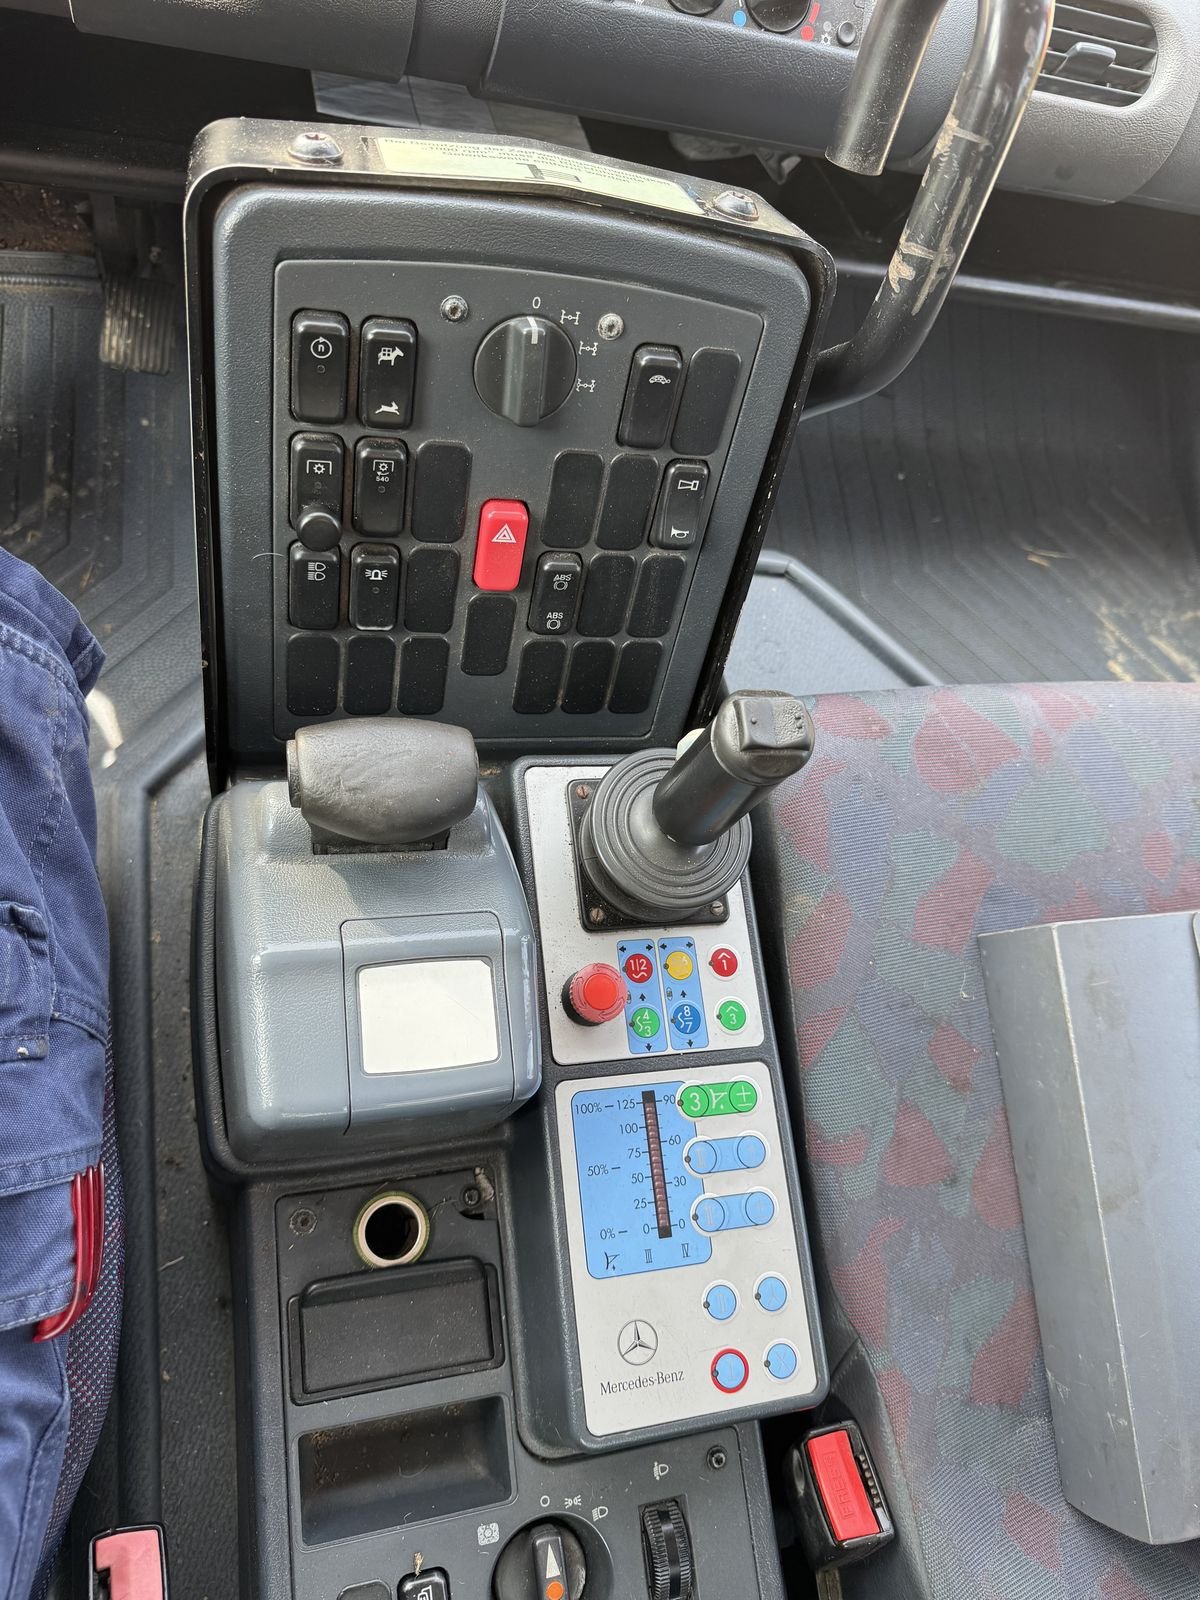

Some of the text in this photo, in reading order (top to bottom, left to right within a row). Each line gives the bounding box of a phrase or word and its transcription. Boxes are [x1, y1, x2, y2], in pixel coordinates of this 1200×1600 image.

[532, 296, 541, 309] 0
[553, 574, 572, 582] ABS
[683, 1005, 691, 1017] 8
[729, 1013, 737, 1025] 3
[685, 1022, 693, 1033] 7
[575, 1094, 676, 1115] 100% 125 90
[689, 1092, 701, 1111] 3
[620, 1122, 639, 1135] 100
[668, 1134, 681, 1145] 60
[627, 1147, 641, 1159] 75
[587, 1163, 609, 1177] 50%
[631, 1172, 644, 1184] 50
[673, 1175, 687, 1187] 30
[633, 1197, 647, 1210] 25
[642, 1223, 650, 1234] 0
[678, 1218, 686, 1229] 0
[600, 1227, 616, 1240] 0%
[600, 1370, 684, 1396] Mercedes-Benz
